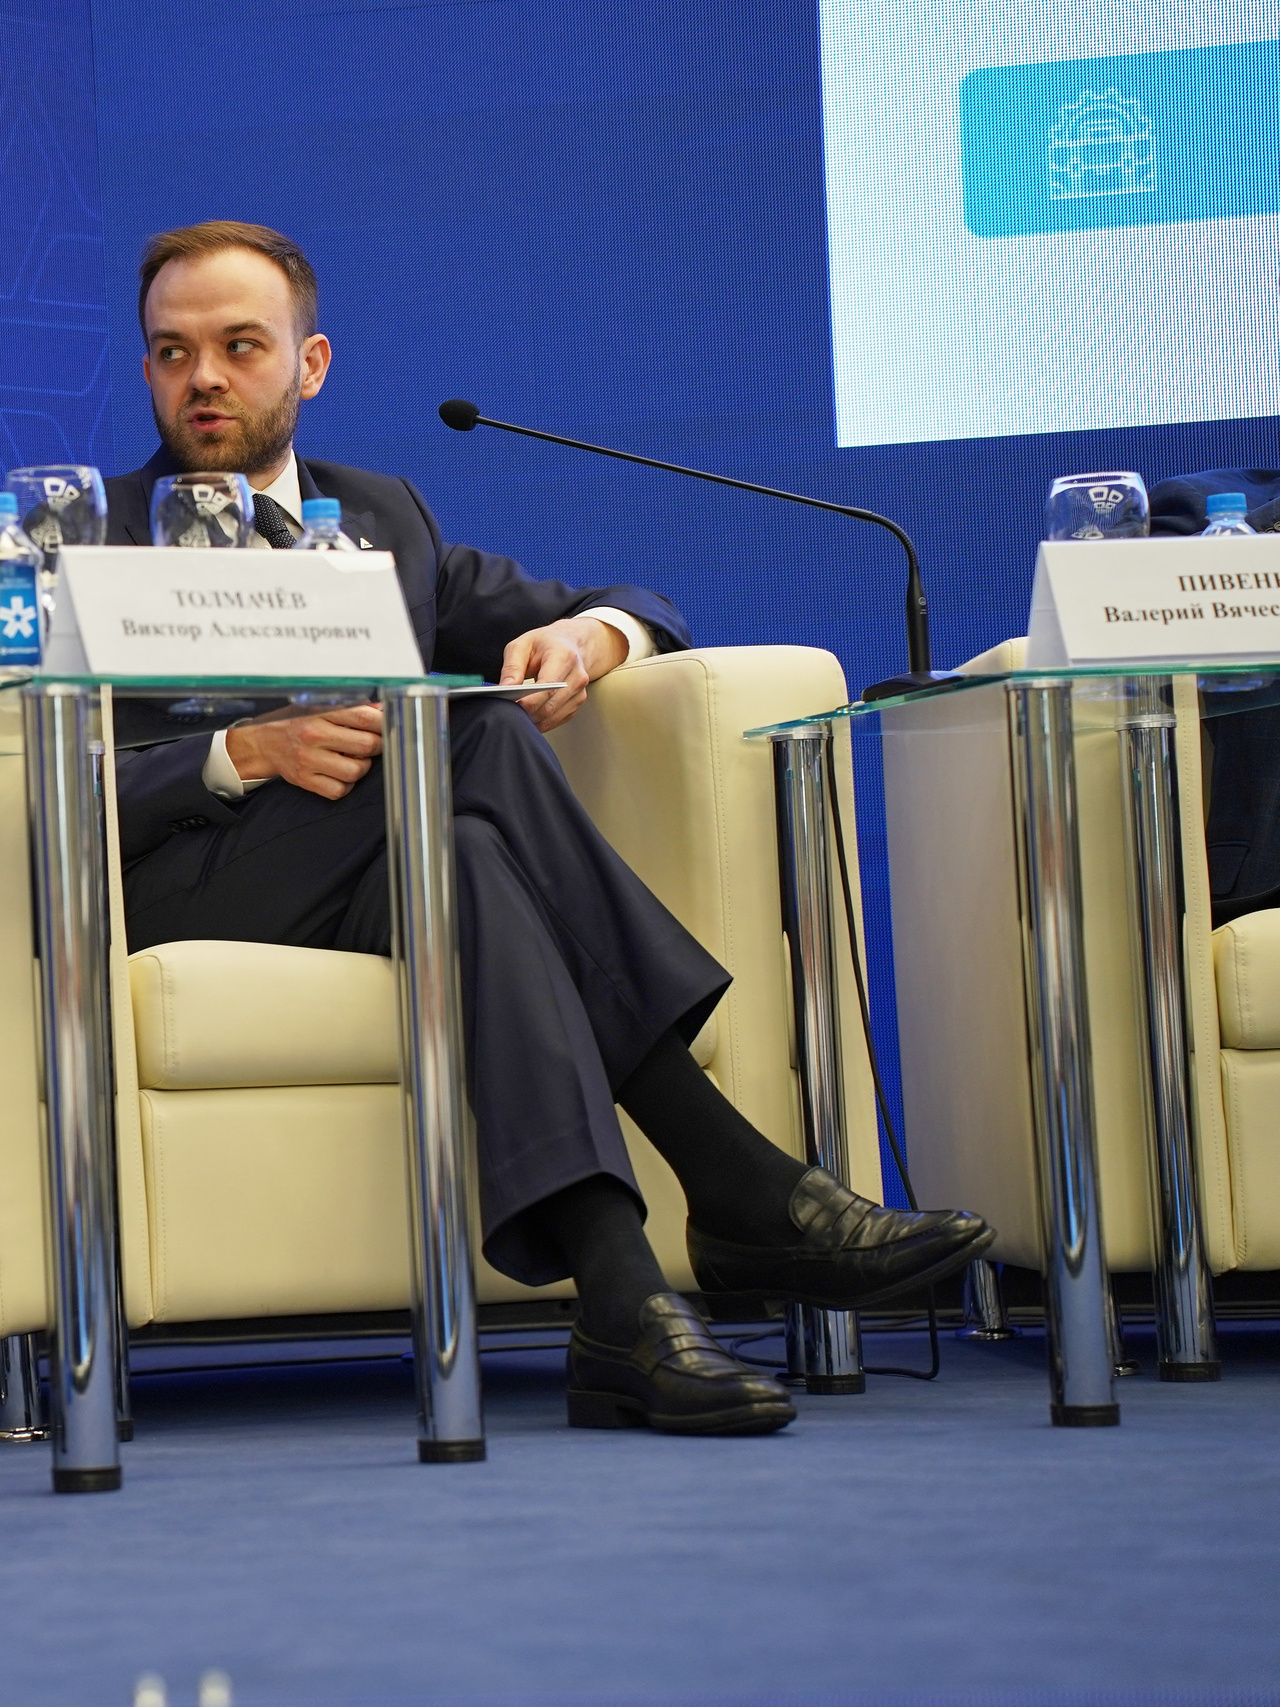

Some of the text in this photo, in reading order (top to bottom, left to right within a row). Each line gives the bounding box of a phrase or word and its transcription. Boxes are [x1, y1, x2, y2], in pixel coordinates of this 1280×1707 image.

[172, 587, 308, 610] ТОЛМАЧЁВ
[1103, 602, 1205, 626] Валерий
[121, 619, 372, 643] Виктор Александрович
